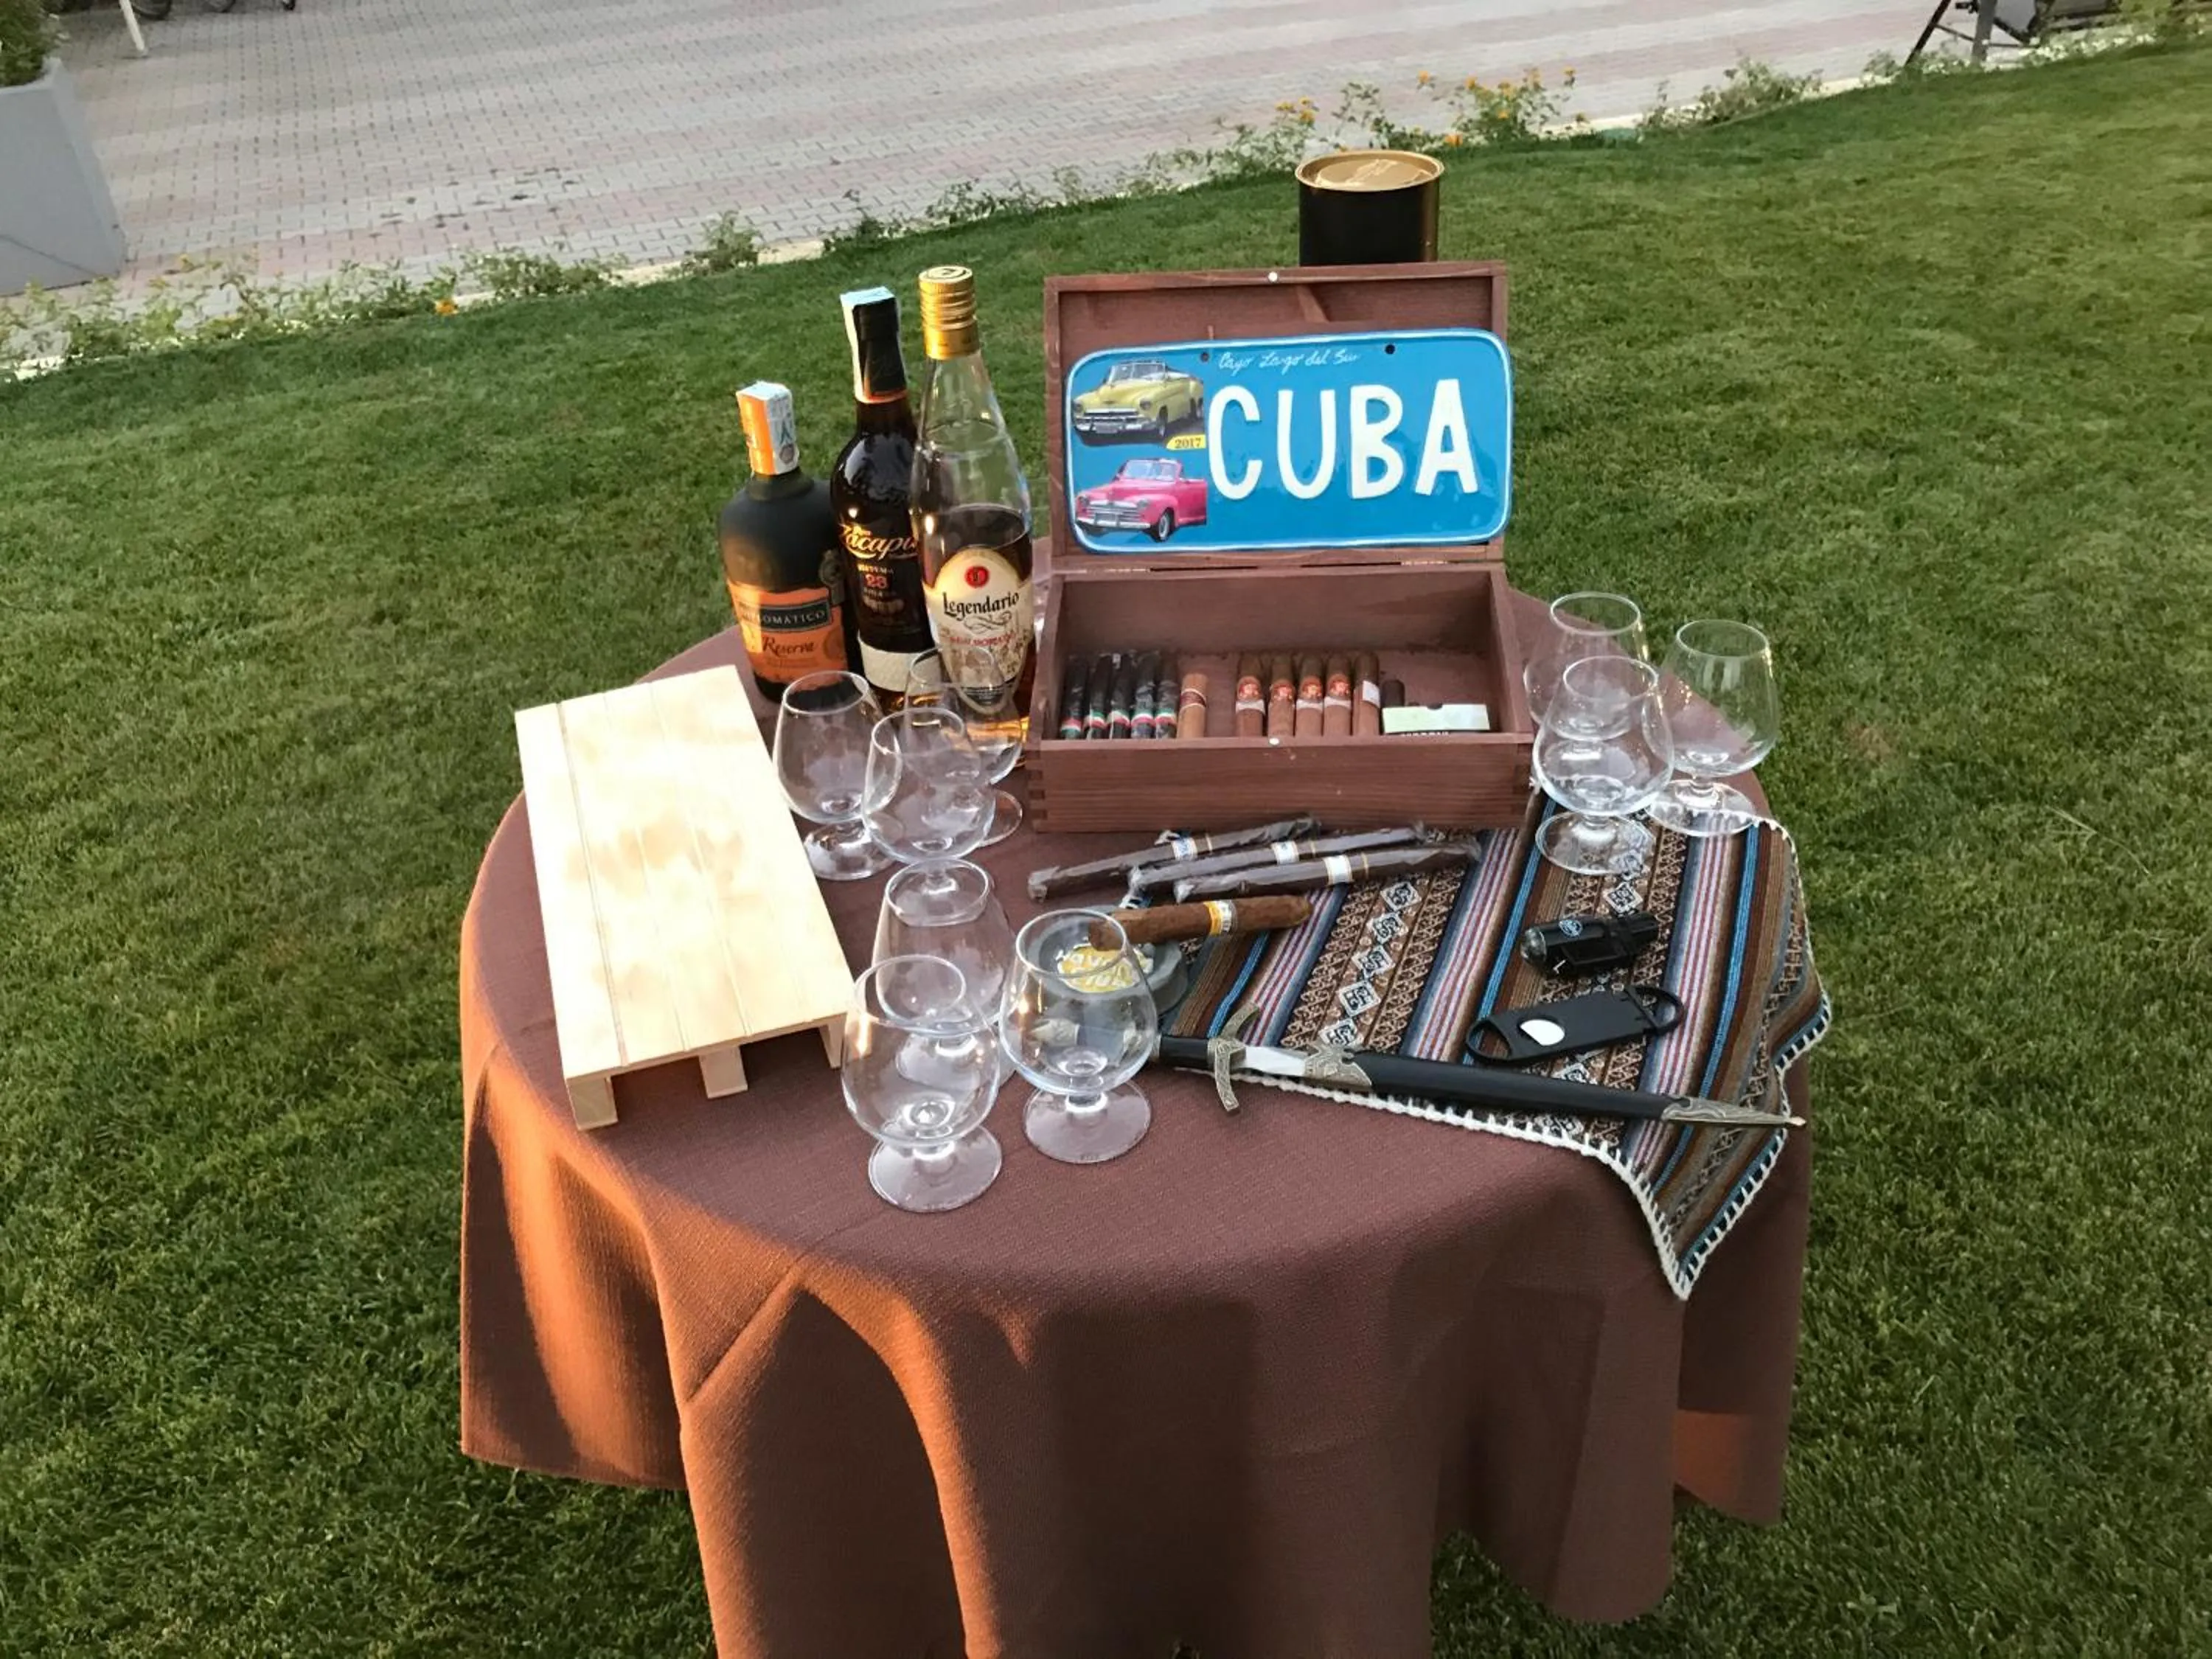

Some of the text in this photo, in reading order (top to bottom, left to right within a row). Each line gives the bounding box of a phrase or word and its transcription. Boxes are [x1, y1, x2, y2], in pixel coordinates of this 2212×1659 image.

[1219, 352, 1253, 377] Cayo
[1304, 348, 1330, 366] del
[1332, 348, 1361, 365] Sur
[1175, 437, 1202, 448] 2017
[1208, 378, 1478, 500] CUBA
[942, 591, 1020, 621] Legendario
[762, 636, 815, 657] Reserva
